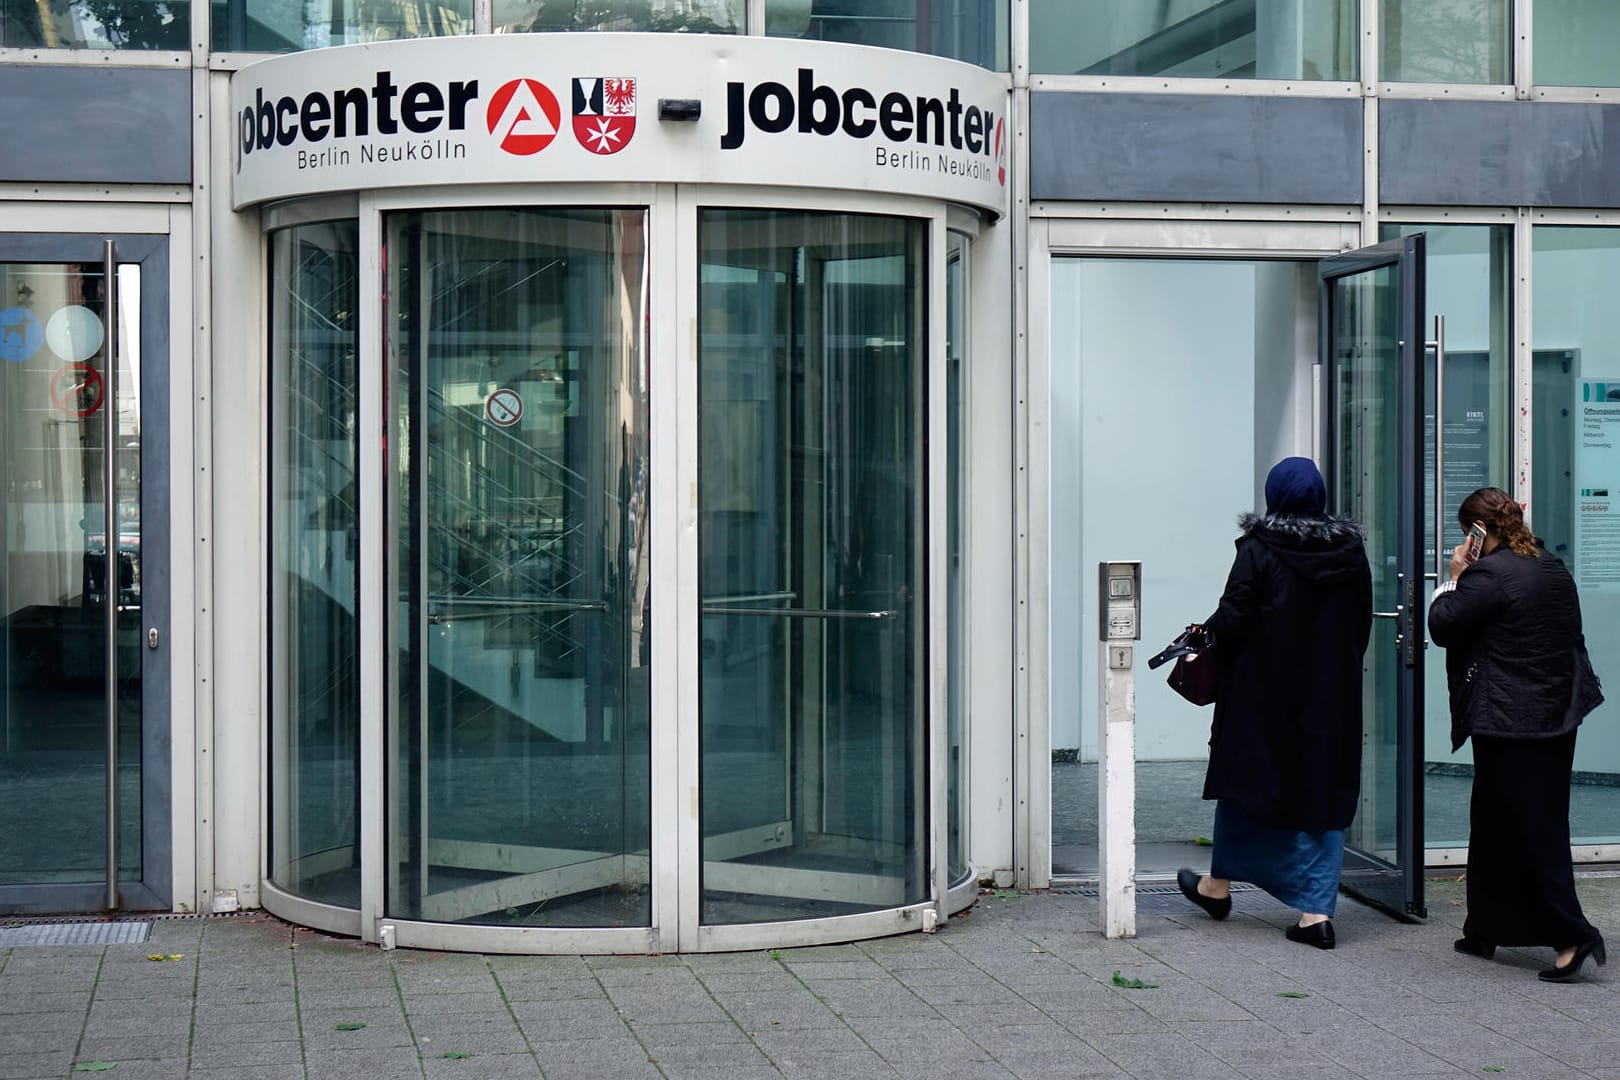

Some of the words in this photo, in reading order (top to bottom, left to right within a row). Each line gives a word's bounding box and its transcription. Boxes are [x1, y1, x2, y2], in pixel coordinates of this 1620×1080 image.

[237, 71, 478, 174] jobcenter
[720, 68, 994, 156] jobcenter
[298, 146, 350, 169] Berlin
[361, 140, 466, 164] Neukölln
[876, 147, 930, 171] Berlin
[938, 154, 991, 182] Neukölln
